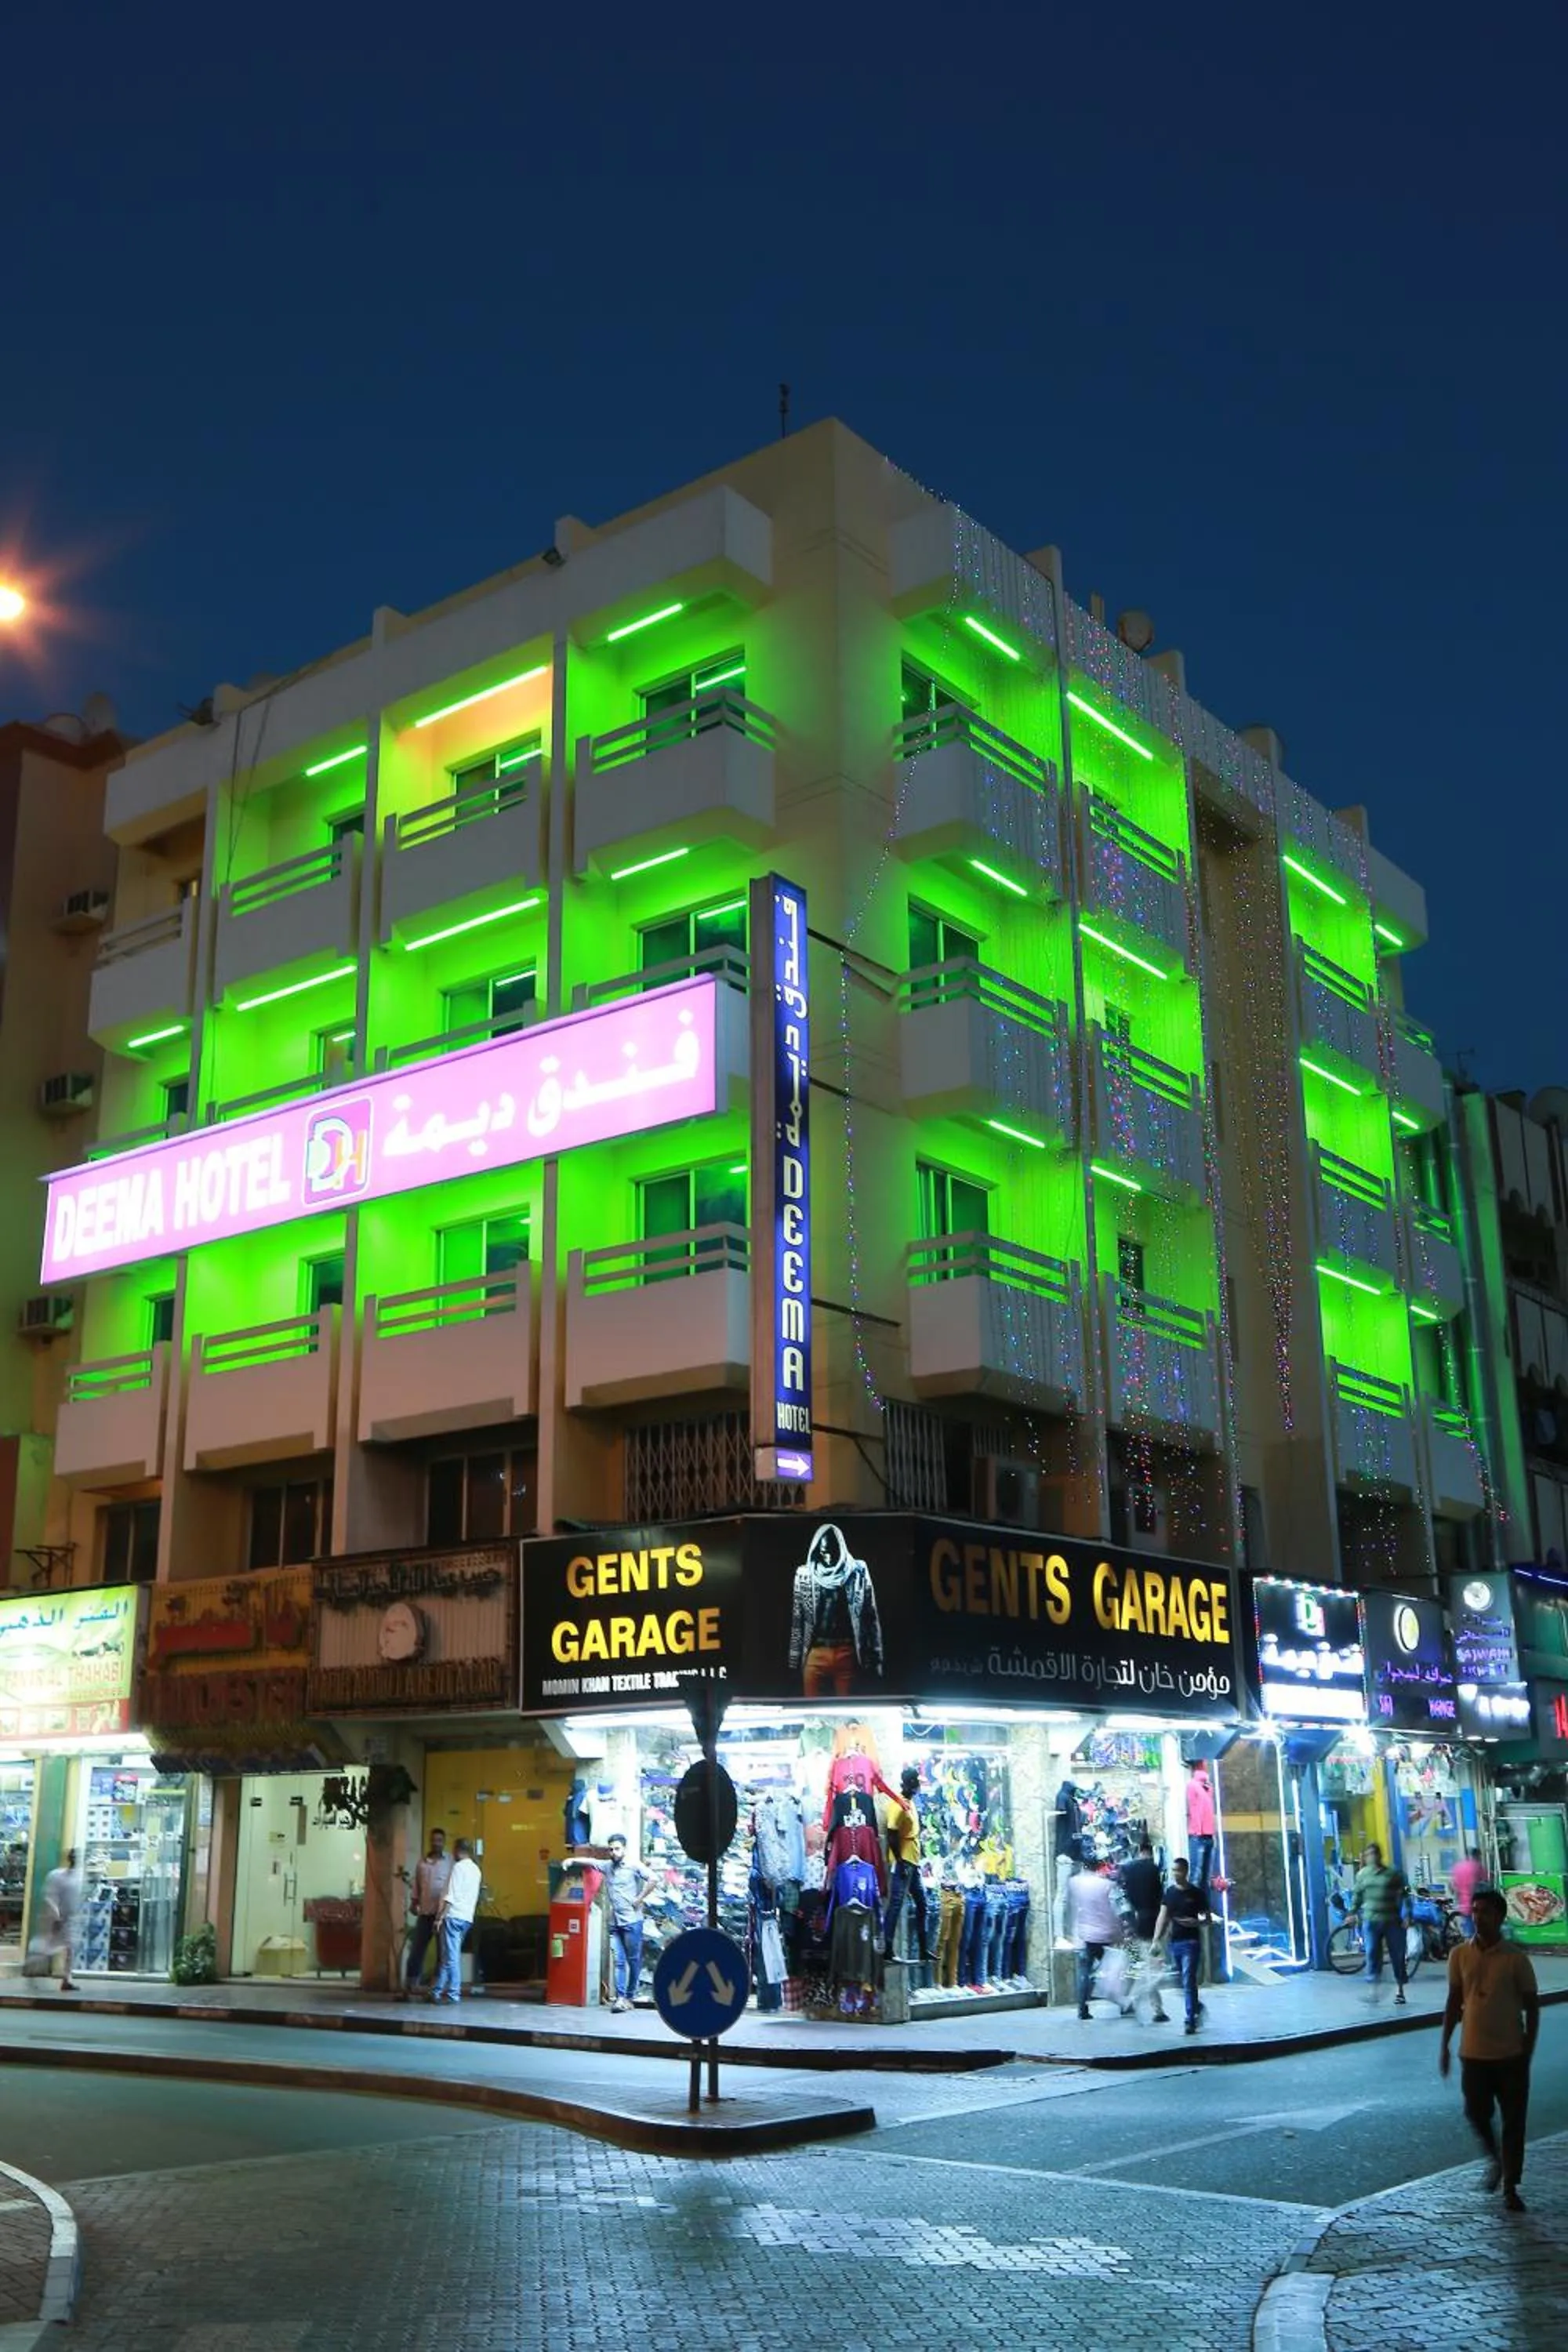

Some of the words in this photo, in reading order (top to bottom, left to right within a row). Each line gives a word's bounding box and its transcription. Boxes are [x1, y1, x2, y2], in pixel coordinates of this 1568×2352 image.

[527, 1009, 700, 1138] فندق
[382, 1092, 515, 1156] ديمة
[51, 1167, 165, 1263] DEEMA
[173, 1132, 292, 1231] HOTEL
[782, 1155, 804, 1392] DEEMA
[777, 1401, 811, 1435] HOTEL
[566, 1543, 703, 1599] GENTS
[930, 1537, 1071, 1625] GENTS
[1093, 1562, 1230, 1644] GARAGE
[551, 1606, 720, 1664] GARAGE
[581, 1676, 610, 1693] KHAN
[611, 1672, 652, 1692] TEXTILE
[1138, 1661, 1175, 1693] خان
